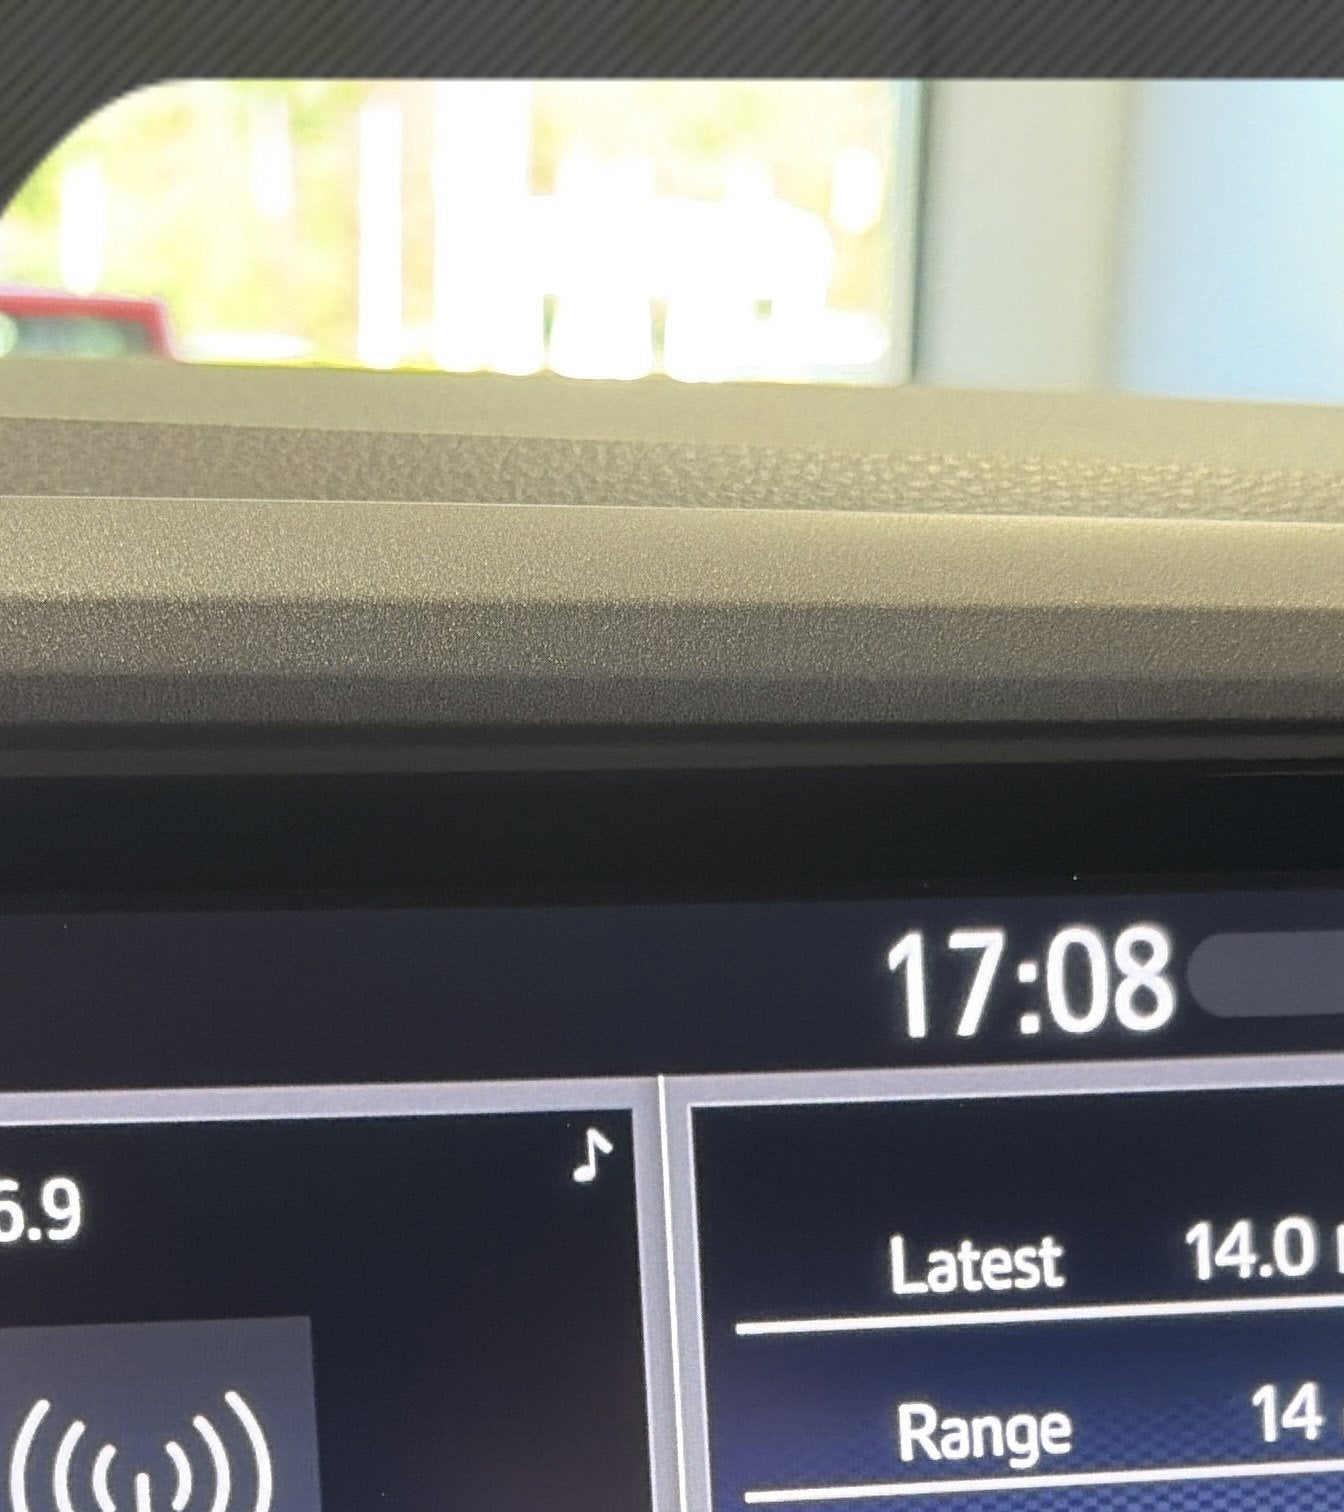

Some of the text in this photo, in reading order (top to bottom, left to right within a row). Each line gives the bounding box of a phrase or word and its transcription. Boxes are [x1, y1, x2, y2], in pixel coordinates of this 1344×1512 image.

[886, 924, 1178, 1040] 17:08
[889, 1233, 1066, 1296] Latest
[1184, 1217, 1317, 1280] 14.0
[897, 1402, 1072, 1470] Range
[1252, 1384, 1323, 1443] 14
